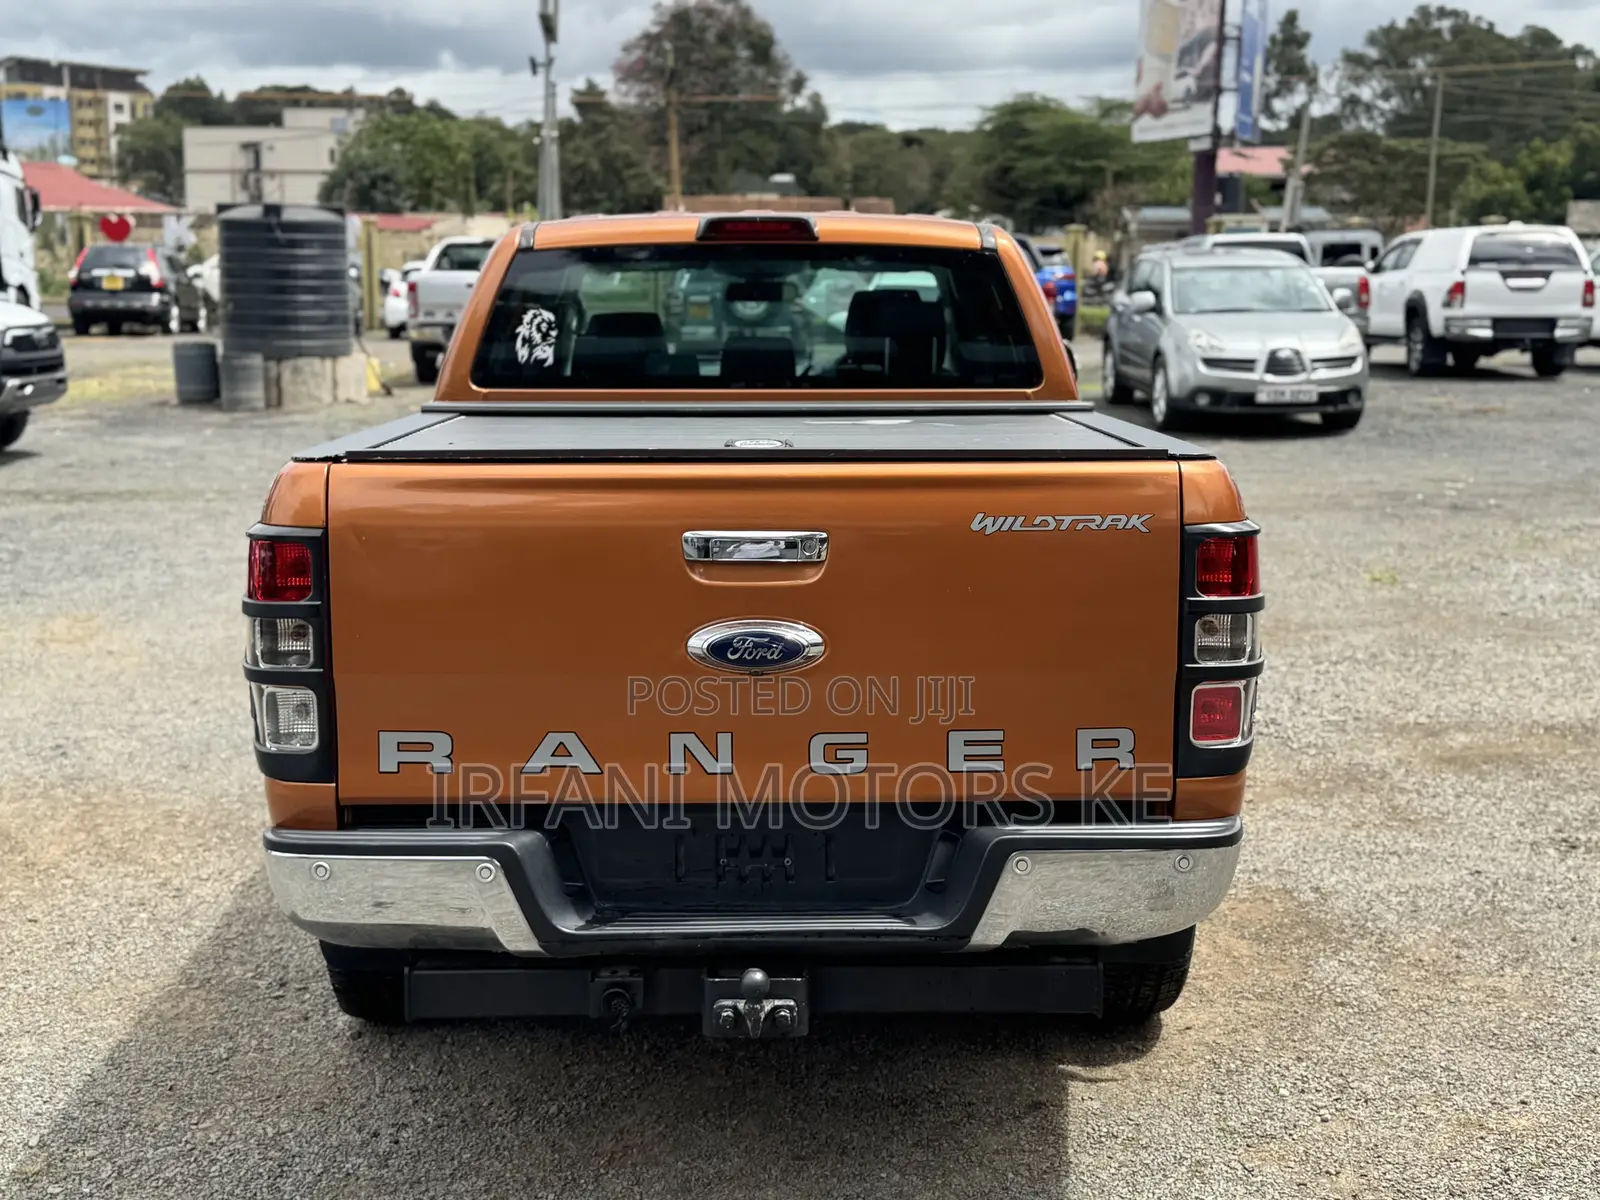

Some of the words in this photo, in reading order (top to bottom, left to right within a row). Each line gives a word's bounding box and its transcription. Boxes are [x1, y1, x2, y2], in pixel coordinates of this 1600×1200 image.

[970, 512, 1155, 536] WILDTRAK
[727, 635, 785, 660] Ford
[378, 727, 1136, 774] RANGER
